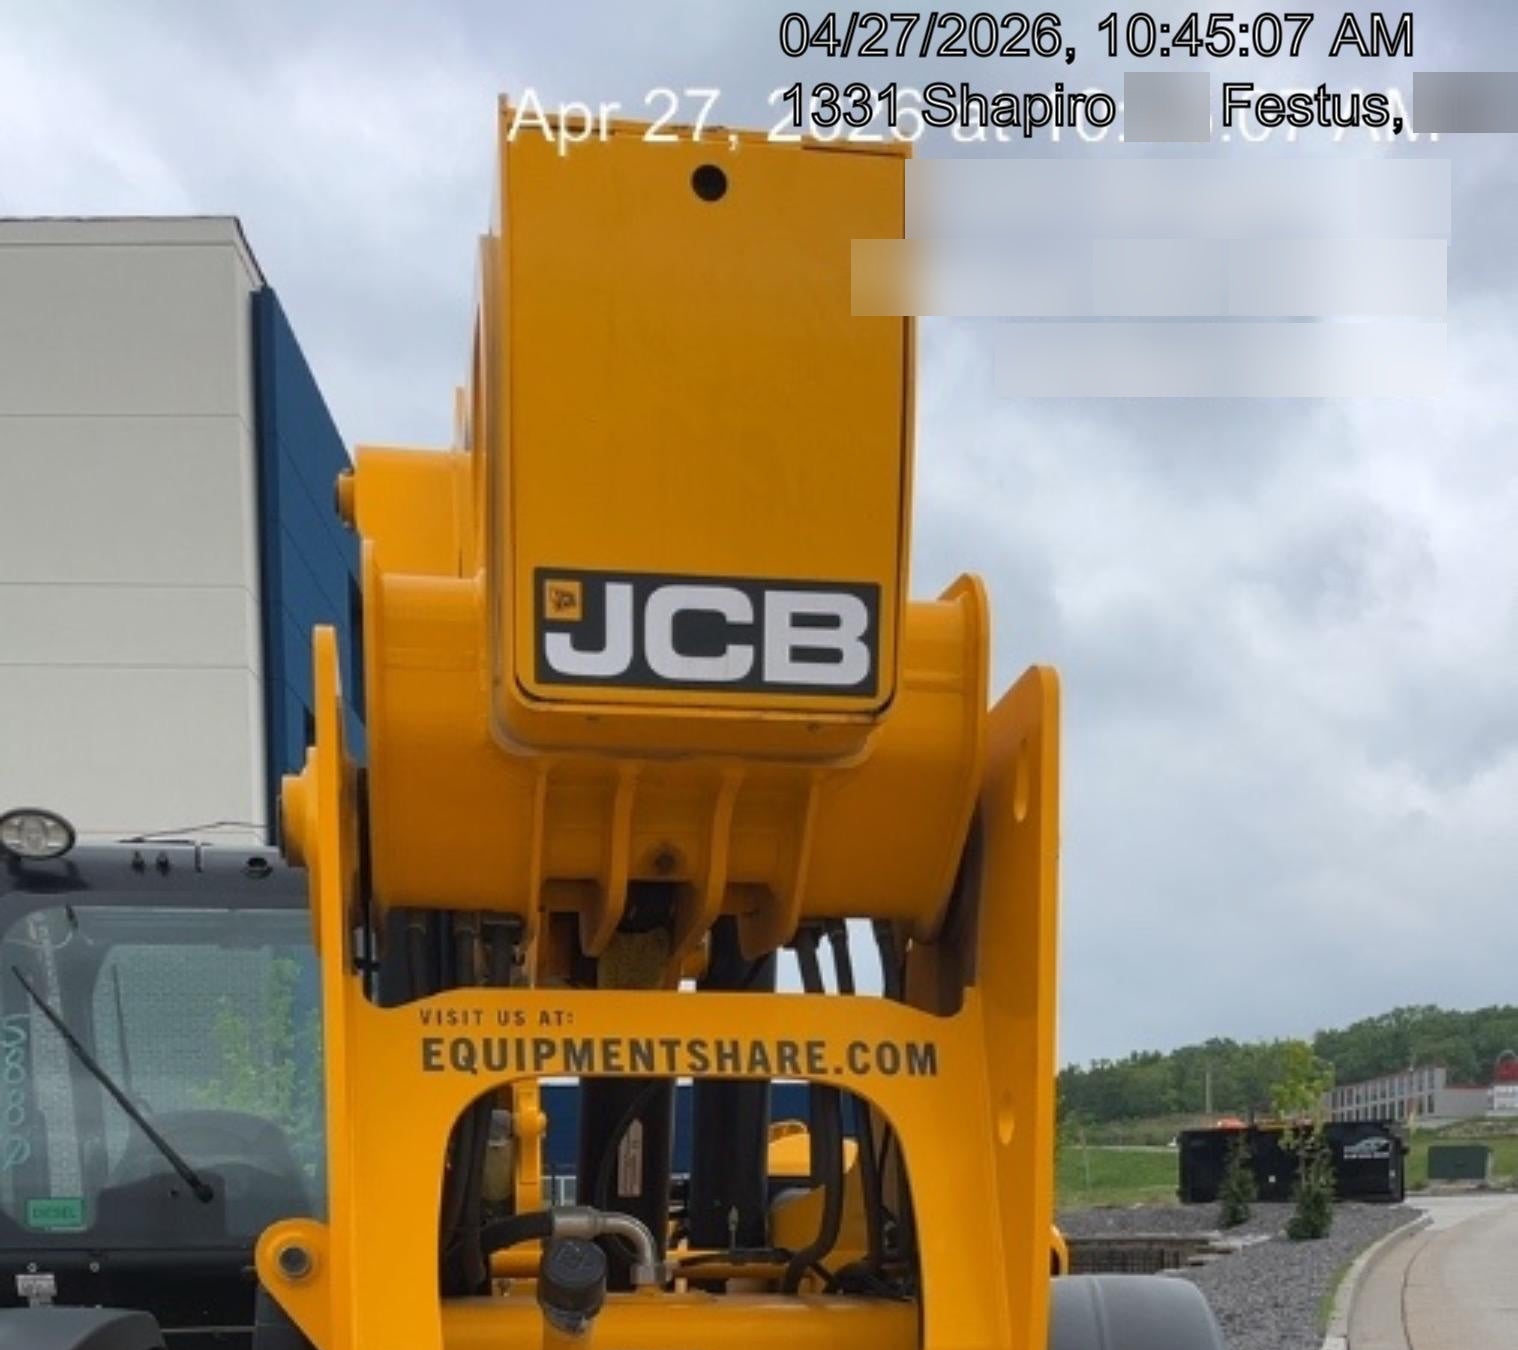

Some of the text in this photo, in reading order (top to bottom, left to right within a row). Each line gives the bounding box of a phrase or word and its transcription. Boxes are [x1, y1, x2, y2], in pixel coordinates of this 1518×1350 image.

[545, 581, 872, 686] JCB
[420, 1009, 574, 1027] VISIT US AT:
[422, 1036, 938, 1077] EQUIPMENTSHARE.COM
